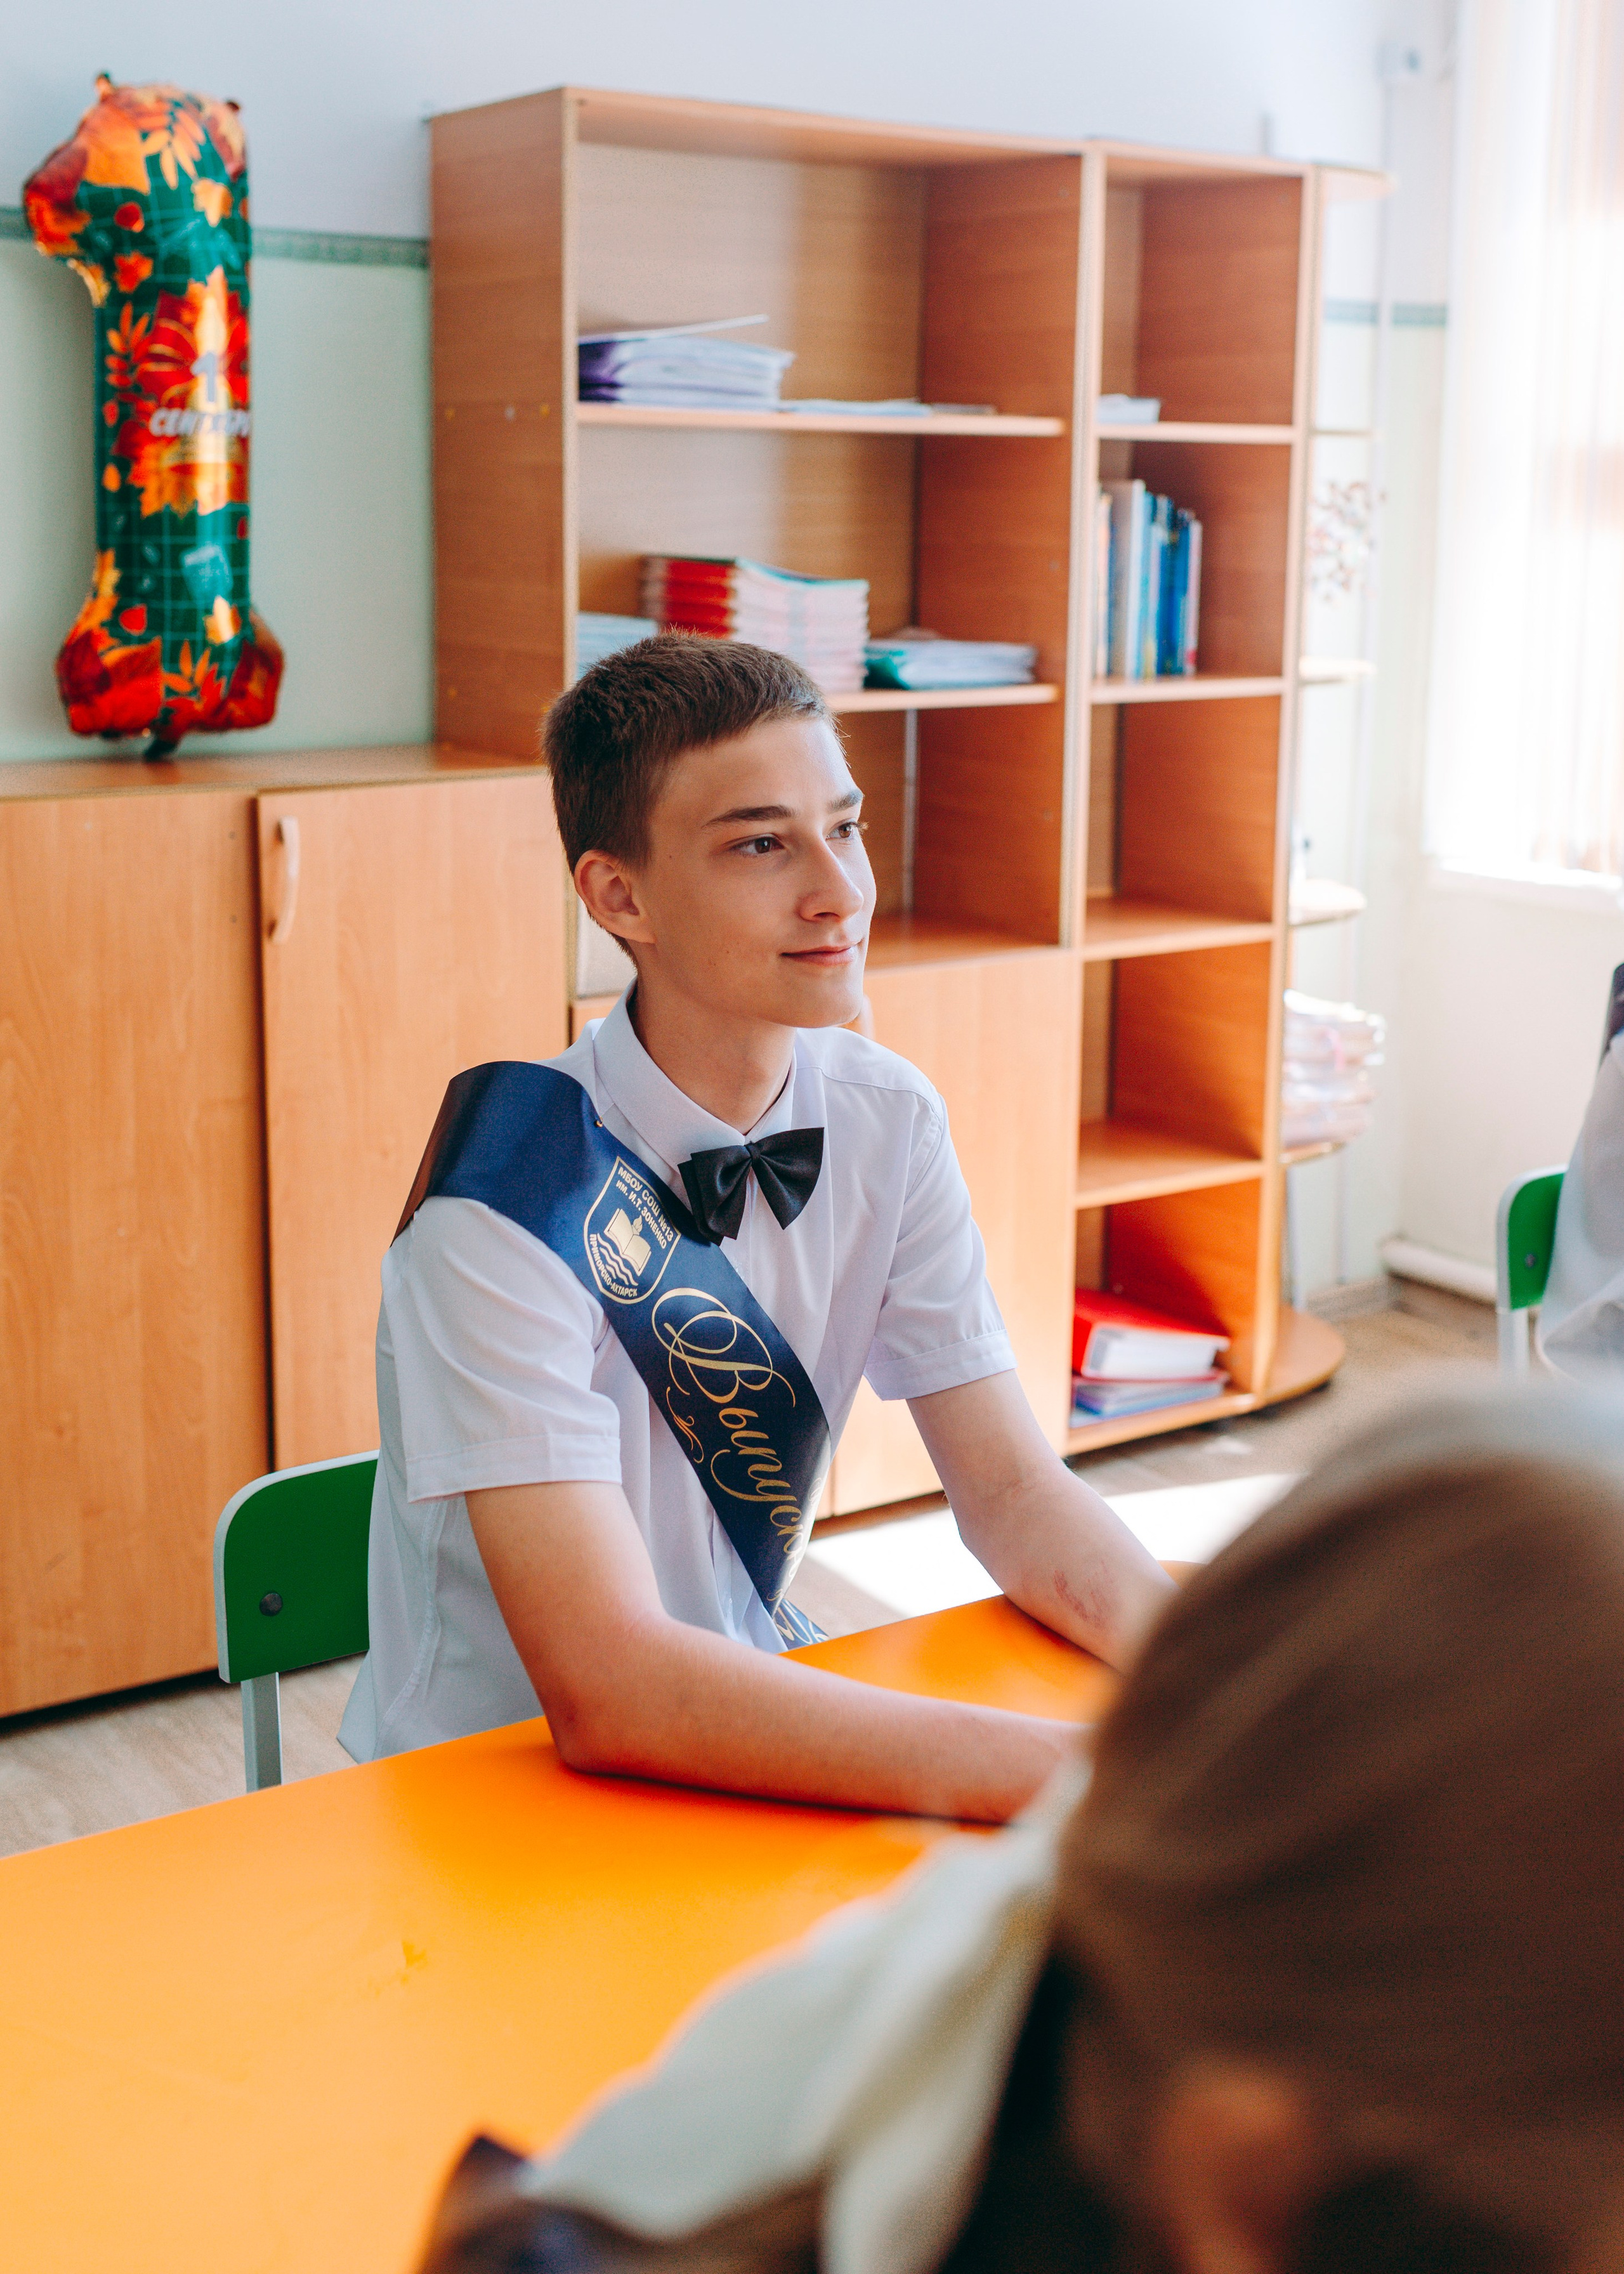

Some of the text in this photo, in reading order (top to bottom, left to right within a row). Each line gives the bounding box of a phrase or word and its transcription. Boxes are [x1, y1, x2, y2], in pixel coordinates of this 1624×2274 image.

[190, 351, 218, 403] 1
[616, 1180, 627, 1196] ИМ.
[641, 1206, 667, 1249] ЗОНЕНКО
[618, 1166, 674, 1241] МБОУ СОШ №13
[590, 1234, 638, 1297] ПРИМОРСКО-АХТАРСК
